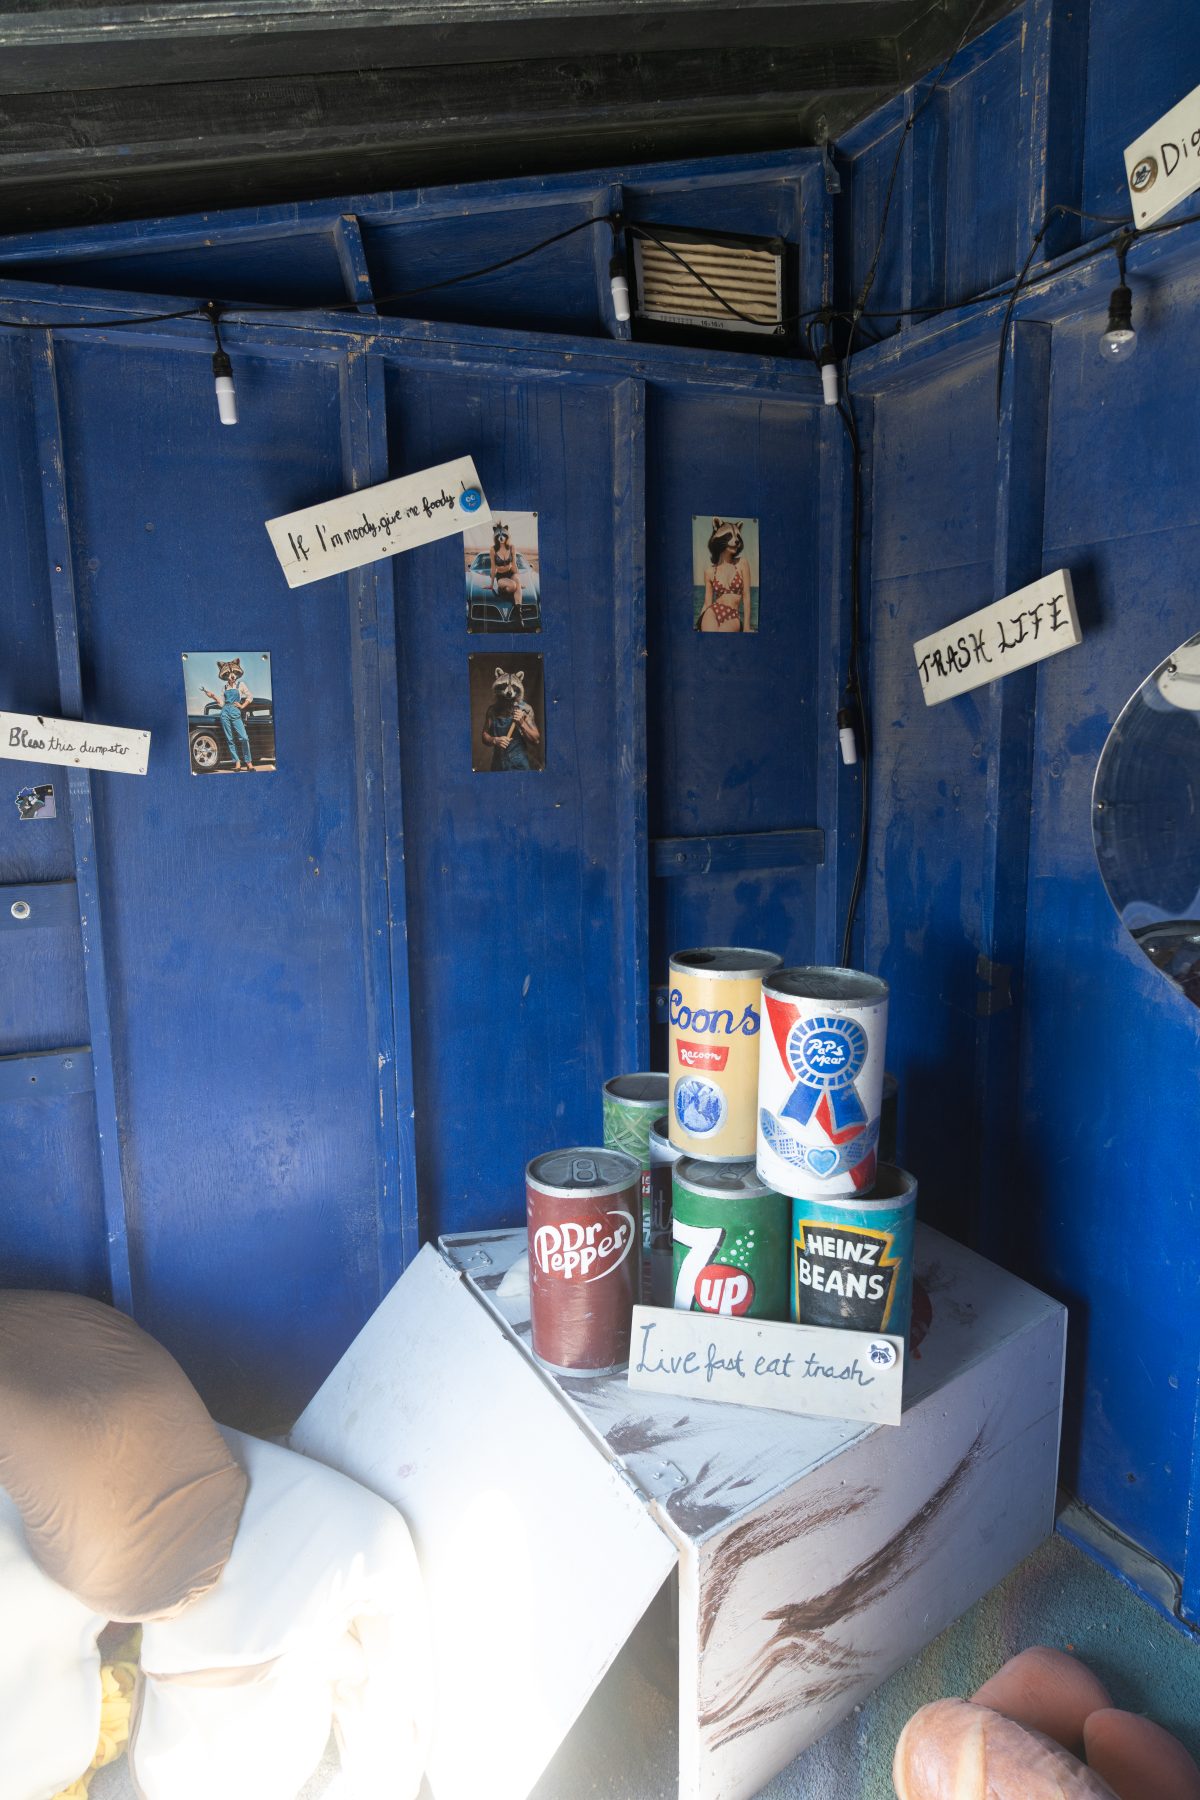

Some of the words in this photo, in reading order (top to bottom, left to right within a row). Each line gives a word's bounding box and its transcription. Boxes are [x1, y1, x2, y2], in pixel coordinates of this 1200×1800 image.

[287, 532, 310, 562] If
[315, 524, 343, 552] I'm
[406, 505, 420, 519] me
[918, 629, 993, 683] TRASH
[998, 594, 1069, 653] LIFE
[9, 726, 45, 750] Bless
[47, 736, 76, 752] this
[79, 740, 130, 756] dumpster
[669, 988, 760, 1036] Coons
[680, 1048, 721, 1065] Racoon
[534, 1224, 628, 1279] Pepper
[559, 1222, 603, 1253] Dr
[807, 1233, 881, 1265] HEINZ
[799, 1256, 885, 1301] BEANS
[636, 1323, 700, 1375] Live
[753, 1352, 792, 1378] eat
[801, 1352, 876, 1387] trash
